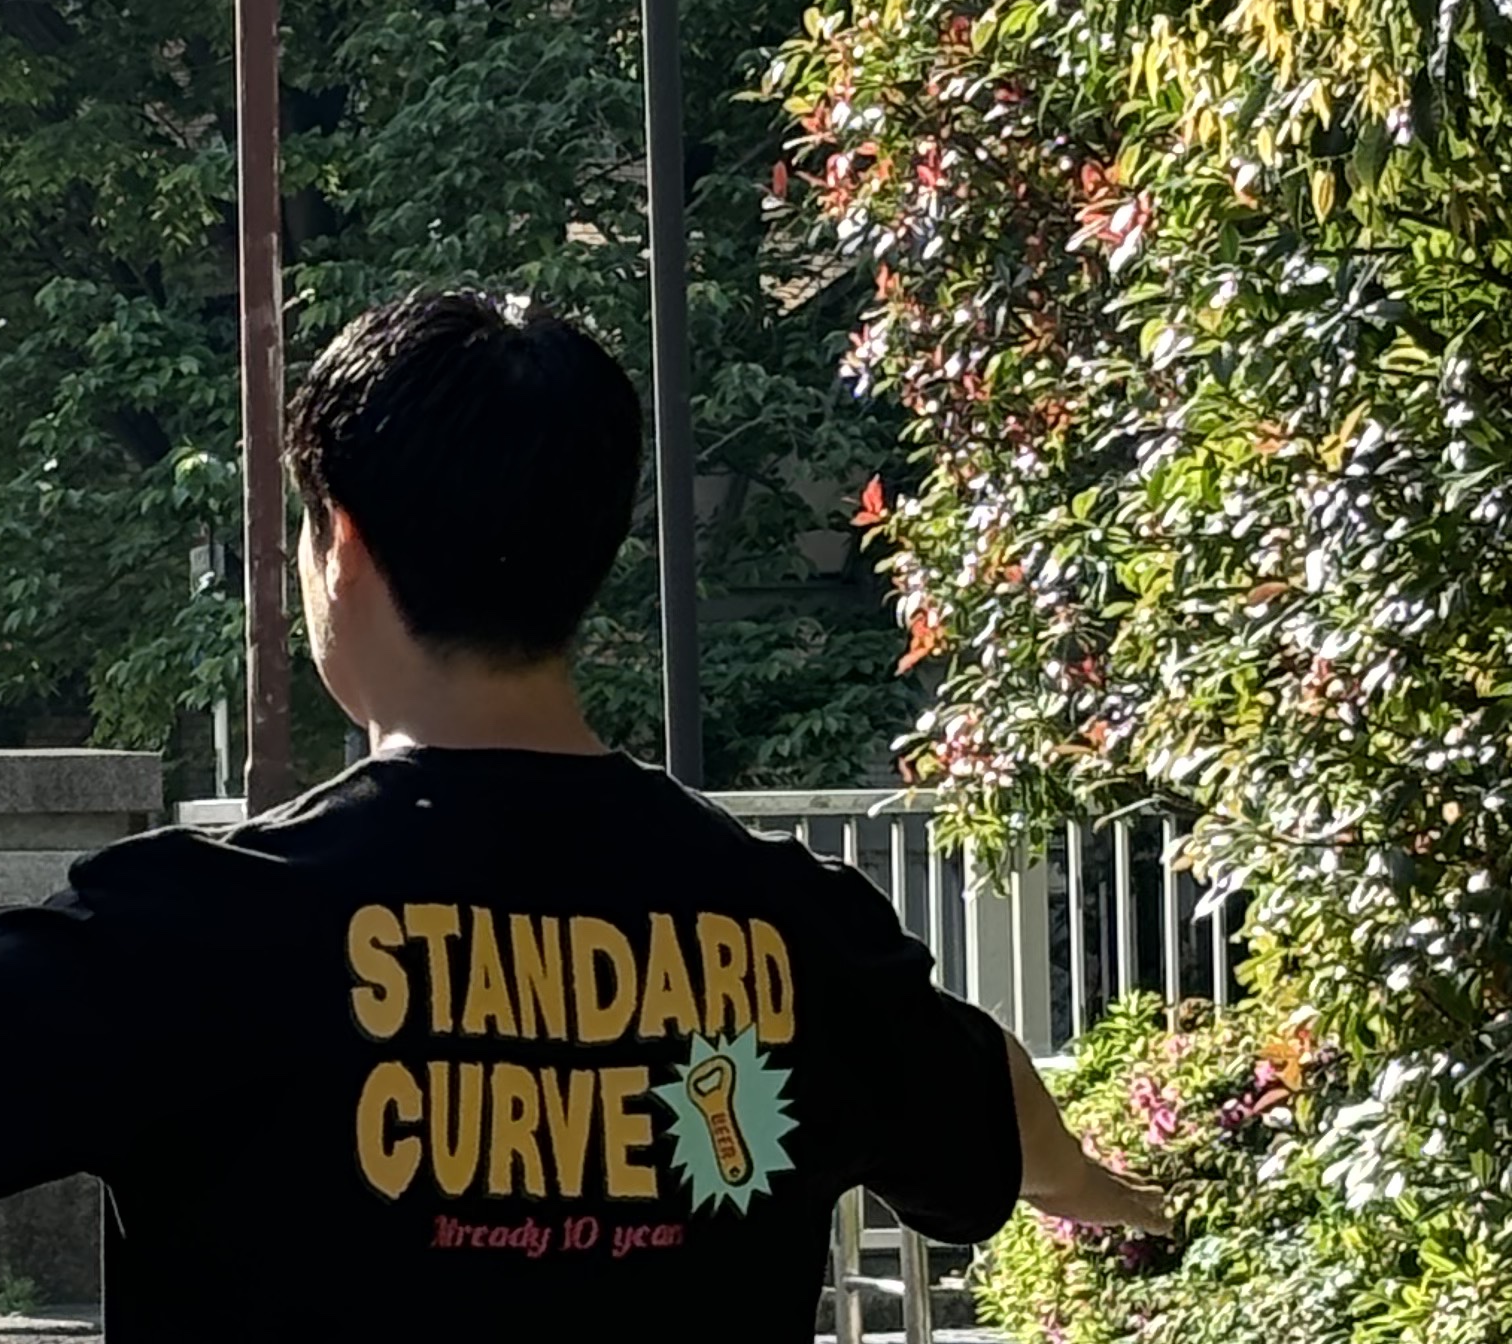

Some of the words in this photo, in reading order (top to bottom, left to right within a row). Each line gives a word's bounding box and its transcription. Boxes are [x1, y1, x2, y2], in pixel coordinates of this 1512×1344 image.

[347, 902, 795, 1043] STANDARD
[356, 1061, 659, 1199] CURVE
[558, 1216, 600, 1251] 10
